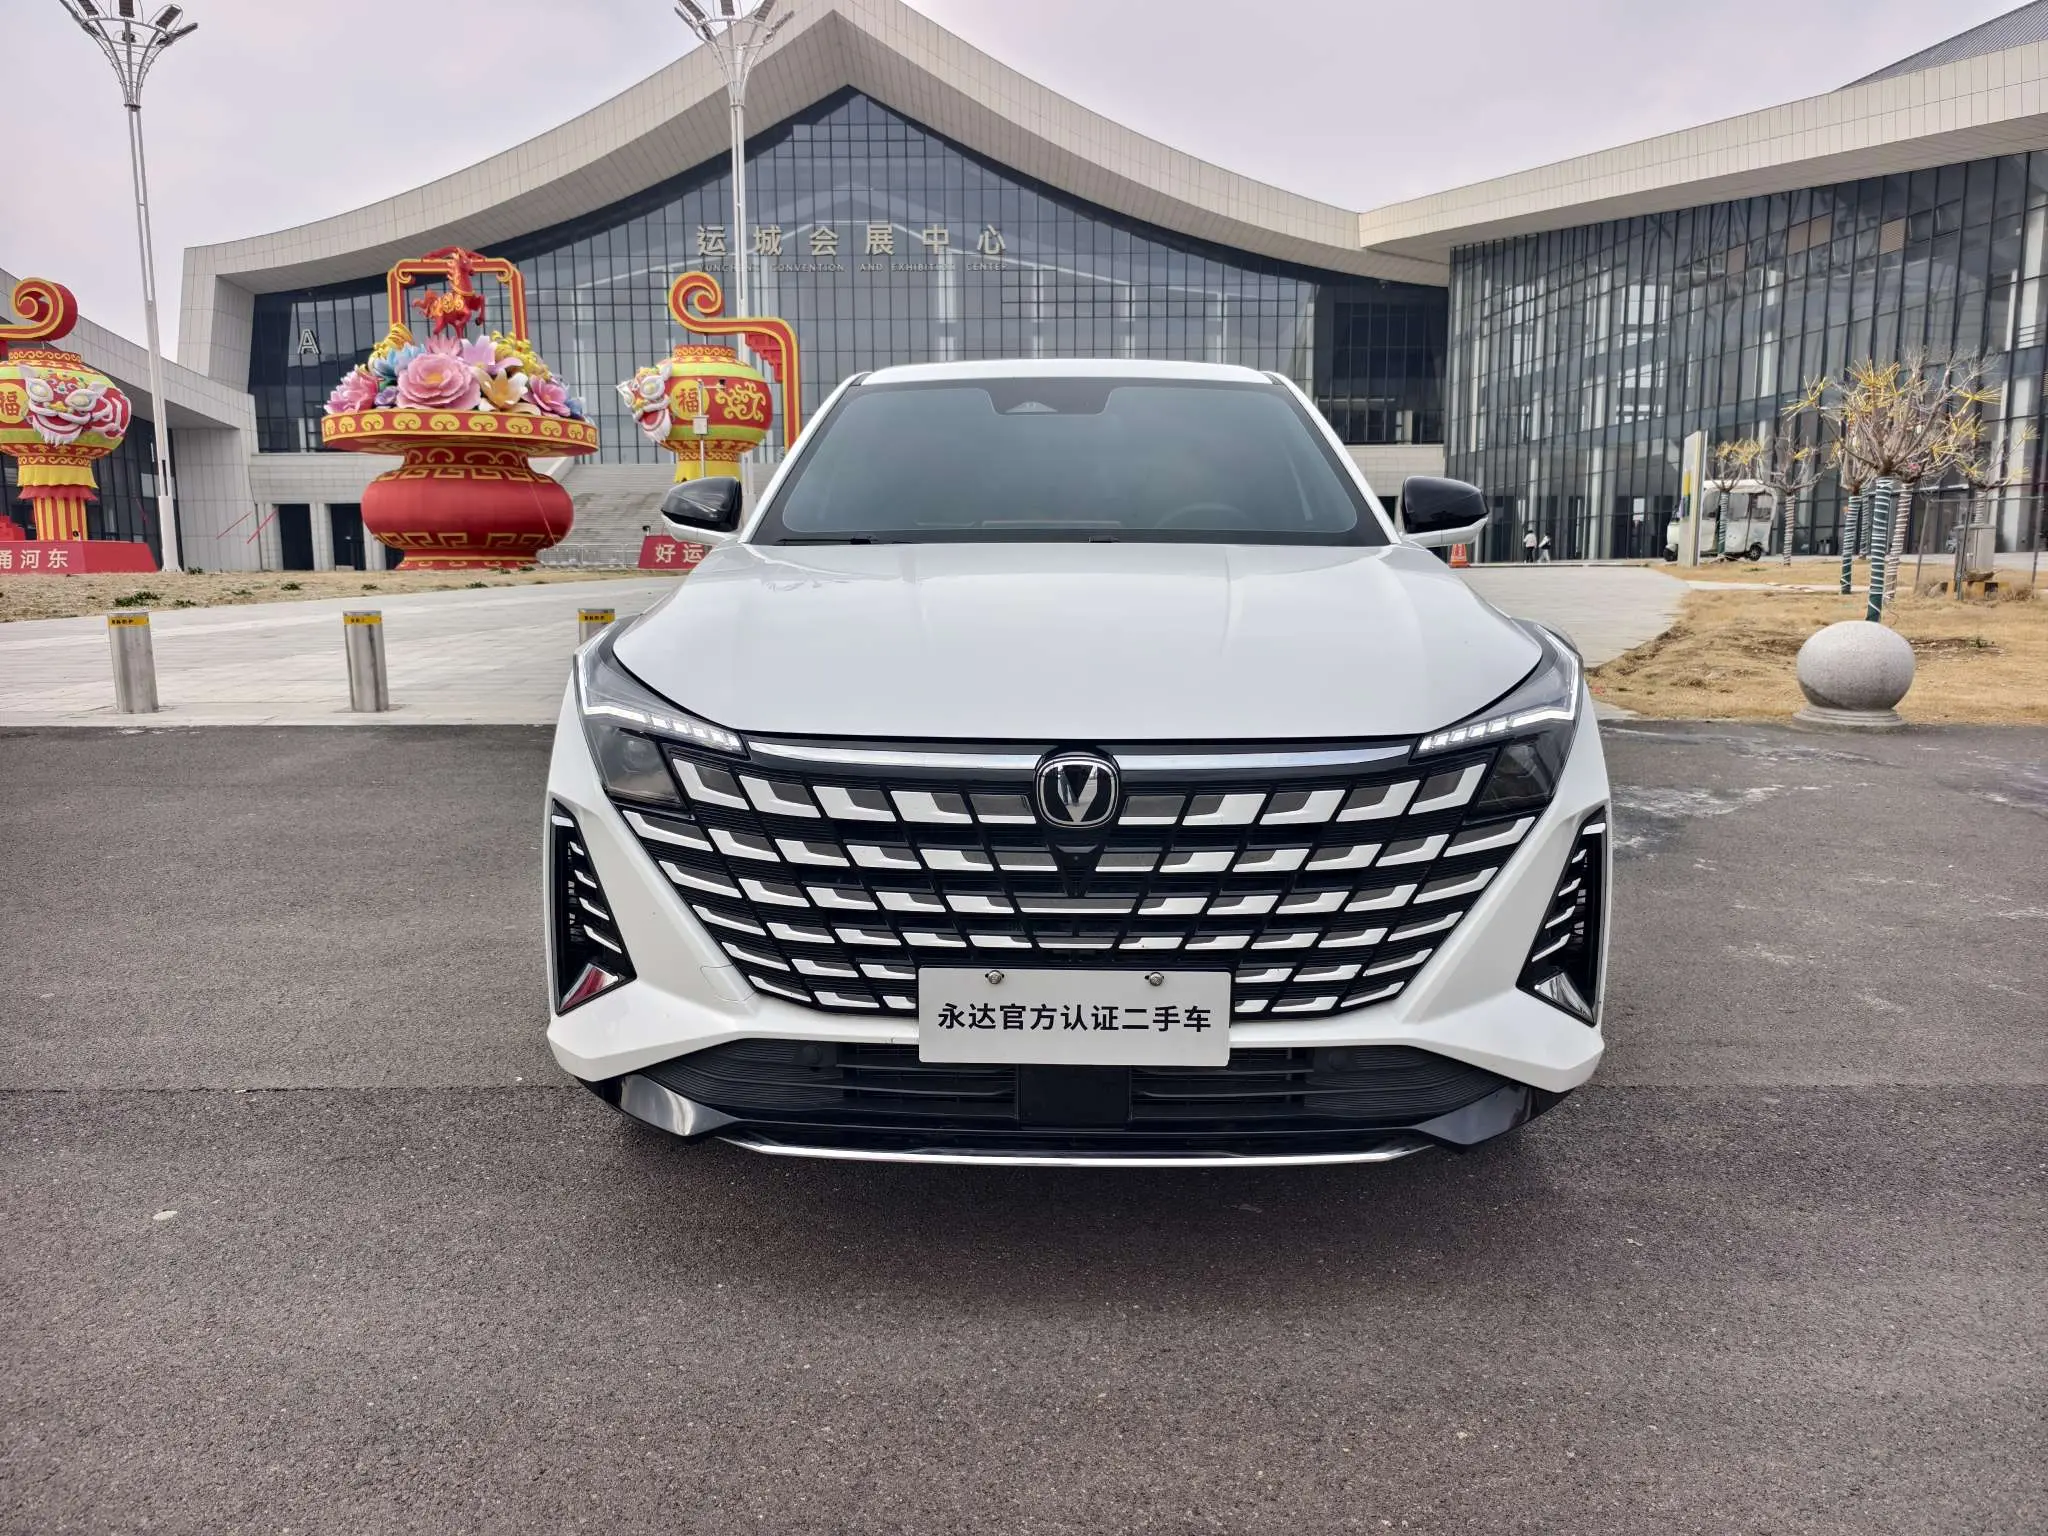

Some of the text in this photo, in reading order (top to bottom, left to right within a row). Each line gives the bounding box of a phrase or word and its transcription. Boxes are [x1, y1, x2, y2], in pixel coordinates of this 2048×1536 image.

[697, 224, 1006, 257] 运城会展中心
[860, 263, 883, 272] AND
[298, 329, 320, 354] A
[674, 387, 699, 412] 福
[937, 1003, 1212, 1032] 永达官方认证二手车
